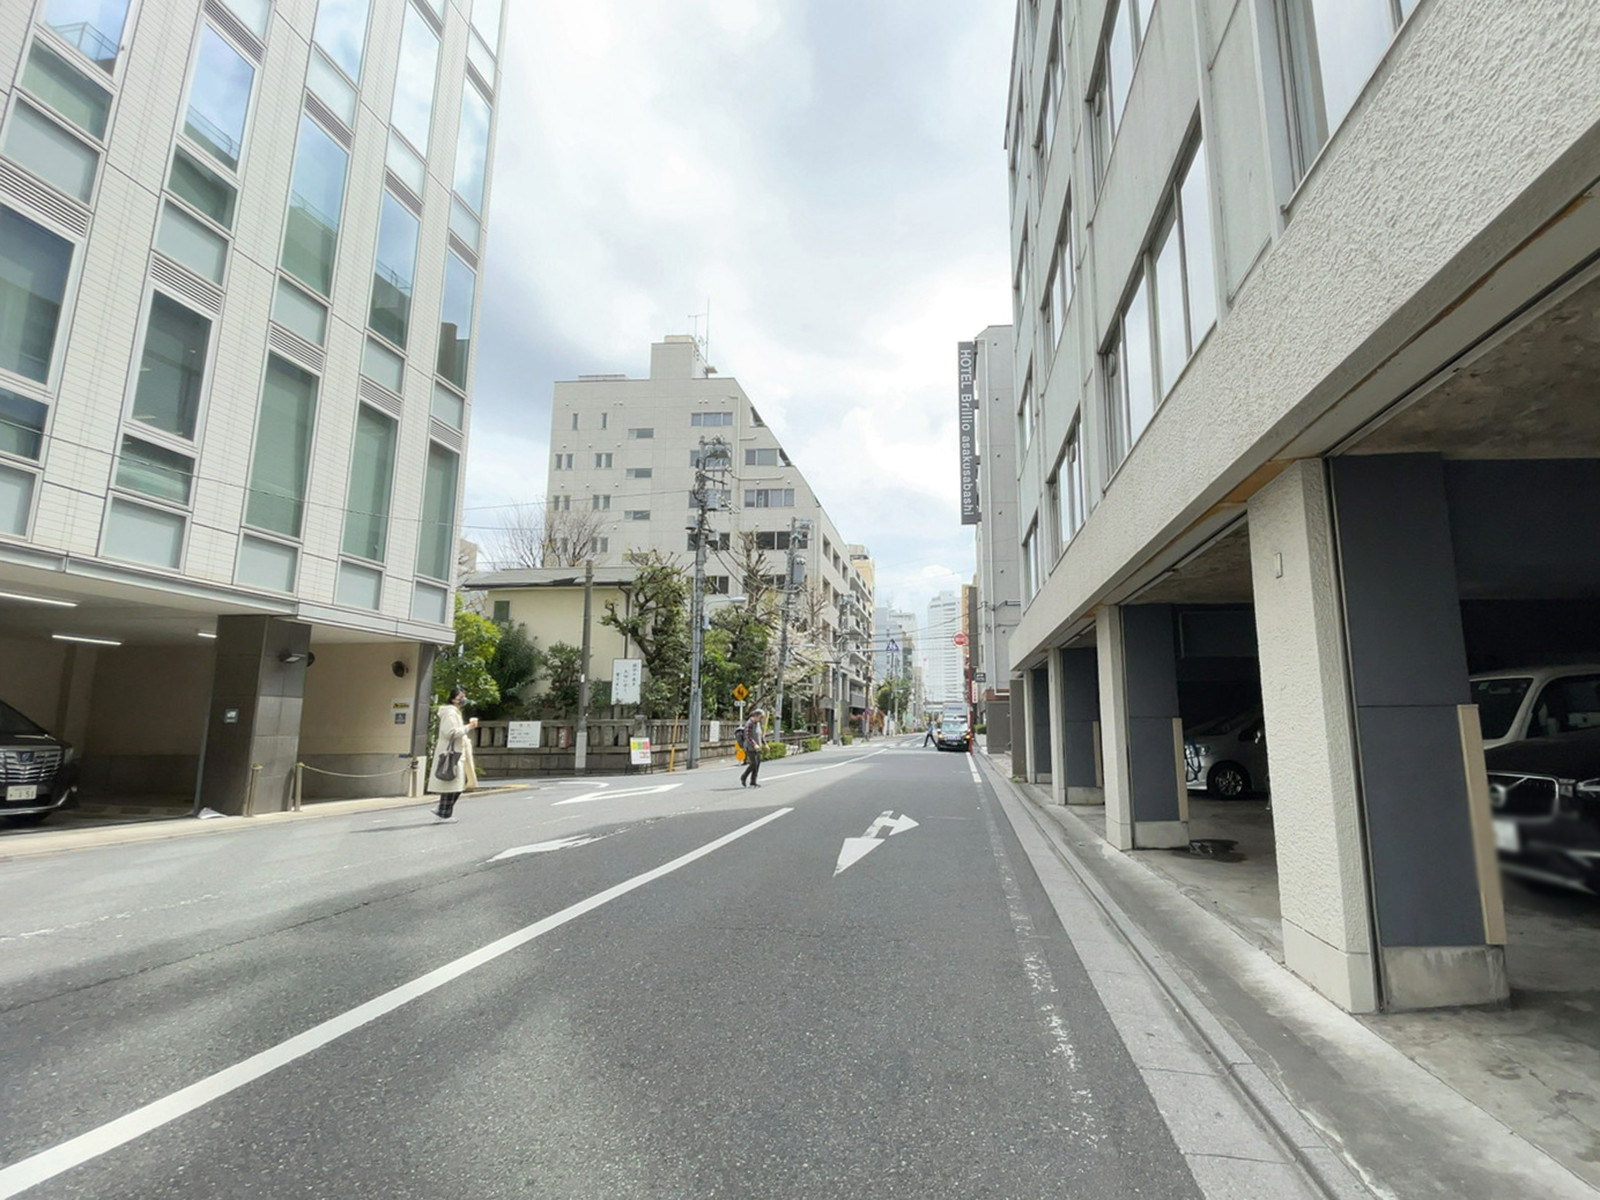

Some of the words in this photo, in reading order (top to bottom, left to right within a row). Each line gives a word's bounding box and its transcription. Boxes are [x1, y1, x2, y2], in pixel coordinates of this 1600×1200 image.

[960, 349, 972, 389] HOTEL
[961, 394, 973, 431] Brillio
[962, 435, 974, 515] asakusabashi
